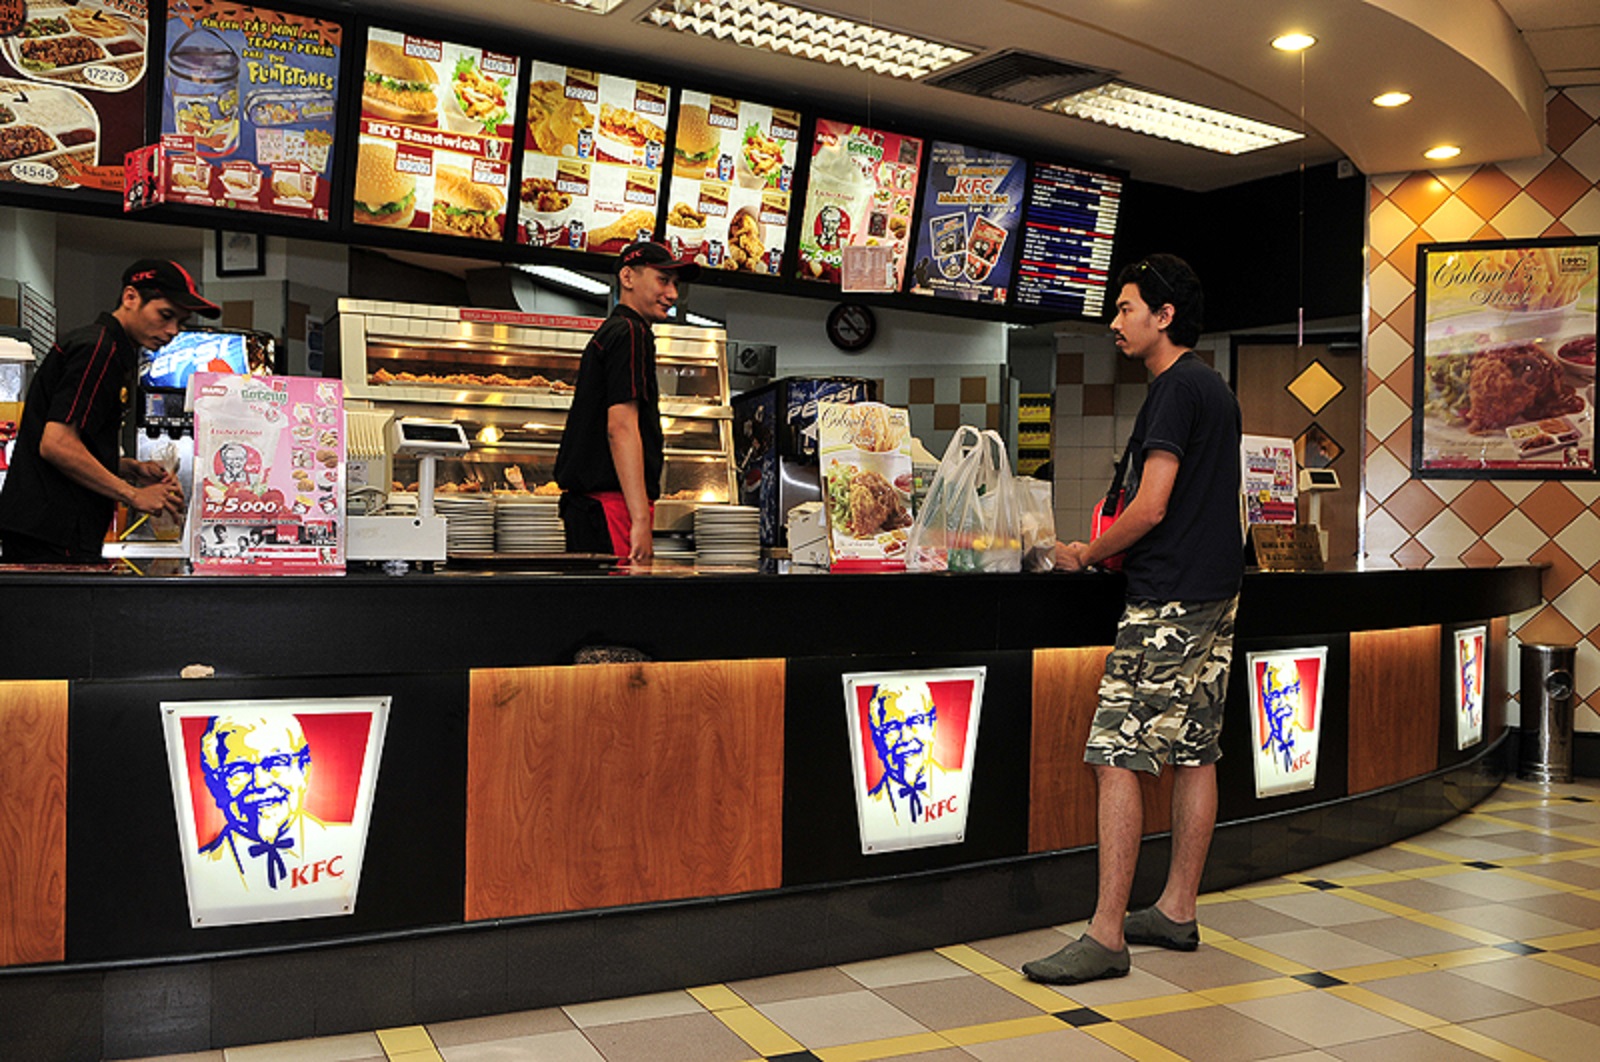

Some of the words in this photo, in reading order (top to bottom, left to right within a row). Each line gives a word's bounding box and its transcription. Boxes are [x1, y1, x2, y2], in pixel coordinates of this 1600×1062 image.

[243, 20, 267, 33] TAS
[271, 23, 299, 37] MINI
[248, 37, 295, 52] TEMPAT
[87, 67, 126, 83] 17273
[368, 122, 401, 139] KFC
[403, 128, 481, 151] Sandwich
[14, 164, 55, 180] 14545
[955, 177, 993, 195] KFC
[1292, 750, 1312, 773] KFC
[925, 795, 958, 823] KFC
[291, 855, 345, 889] KFC
